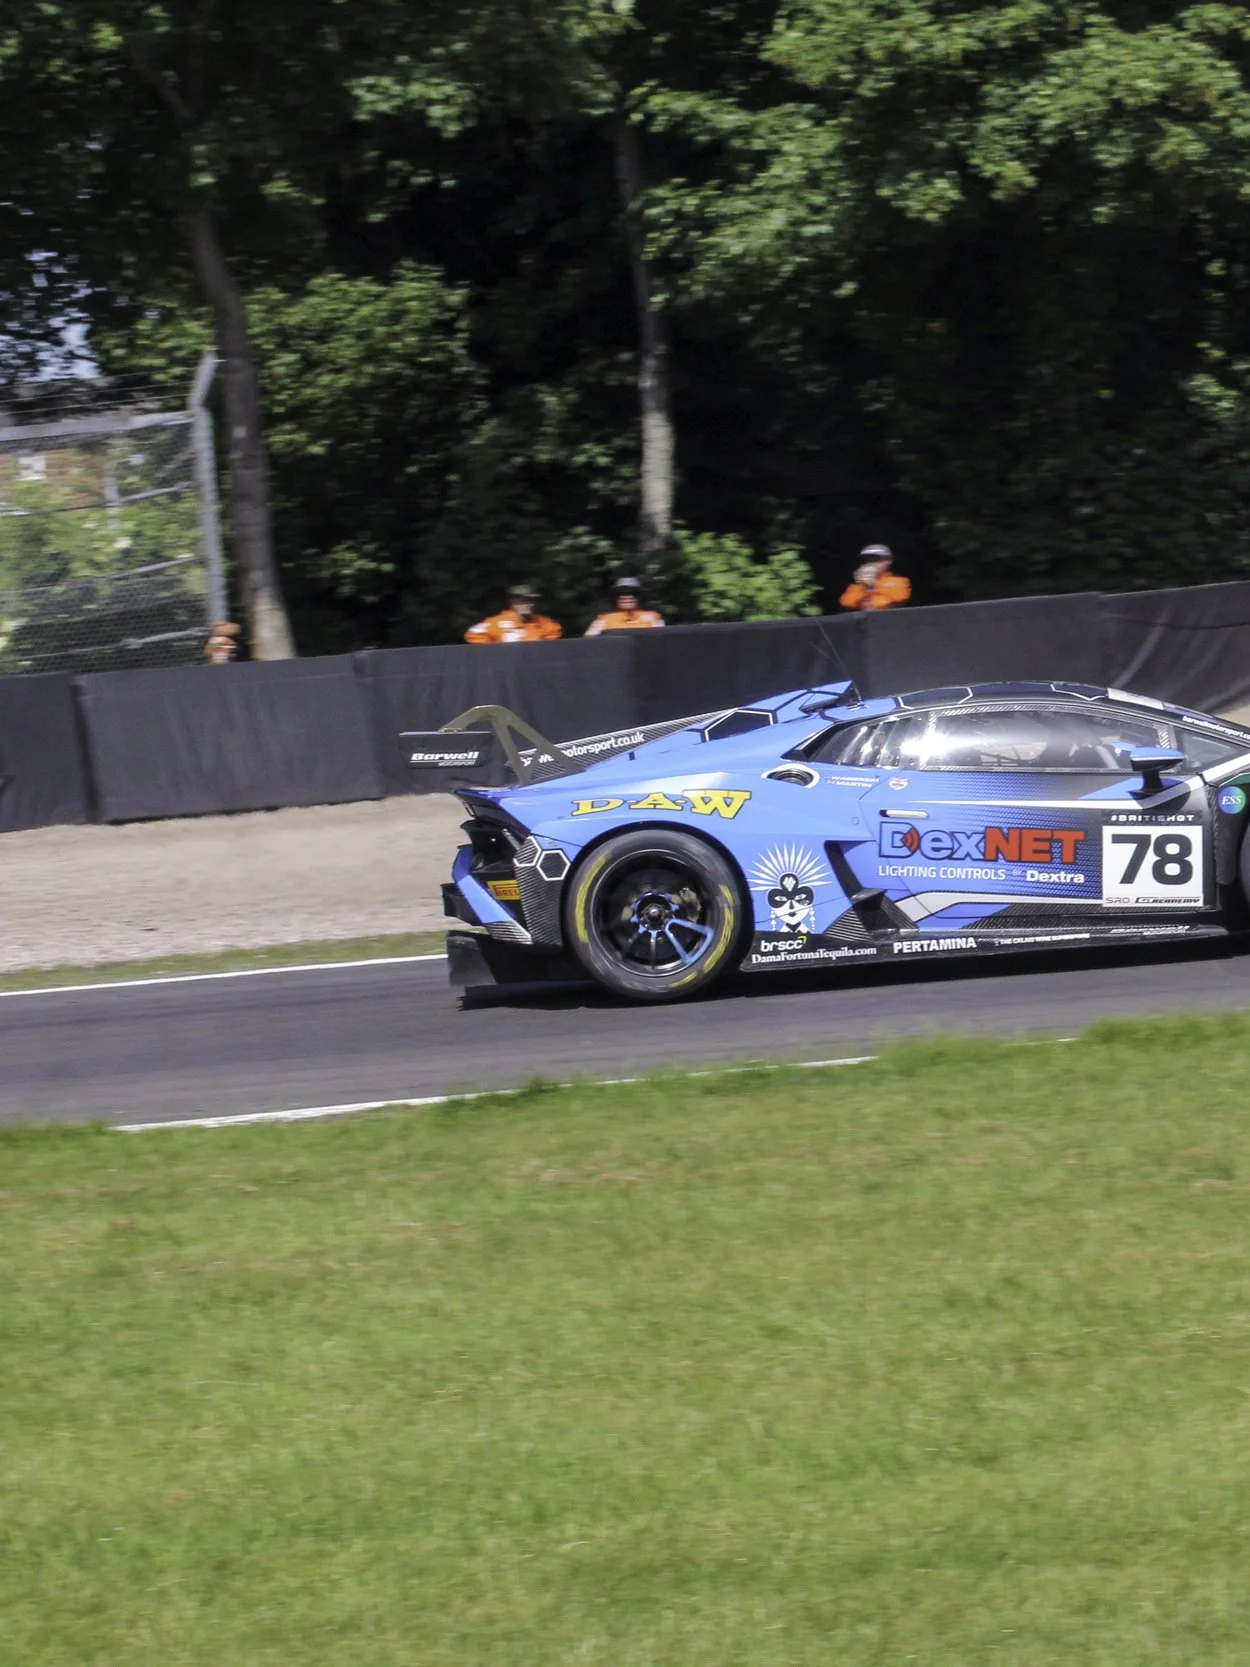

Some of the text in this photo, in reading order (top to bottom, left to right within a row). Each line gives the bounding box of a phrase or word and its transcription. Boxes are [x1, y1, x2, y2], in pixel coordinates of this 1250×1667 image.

[410, 751, 479, 760] Barwell
[1221, 795, 1242, 805] ESS
[1111, 814, 1195, 822] #BRITISHGT
[879, 821, 1086, 866] DexNET
[1111, 833, 1194, 886] 78
[879, 866, 937, 879] LIGHTING
[939, 867, 1006, 880] CONTROLS
[1026, 869, 1085, 884] Dextra
[1105, 896, 1130, 904] SRO
[760, 938, 803, 952] brscc
[893, 937, 977, 954] PERTAMINA
[752, 945, 877, 964] DamaFortunaTequila.com
